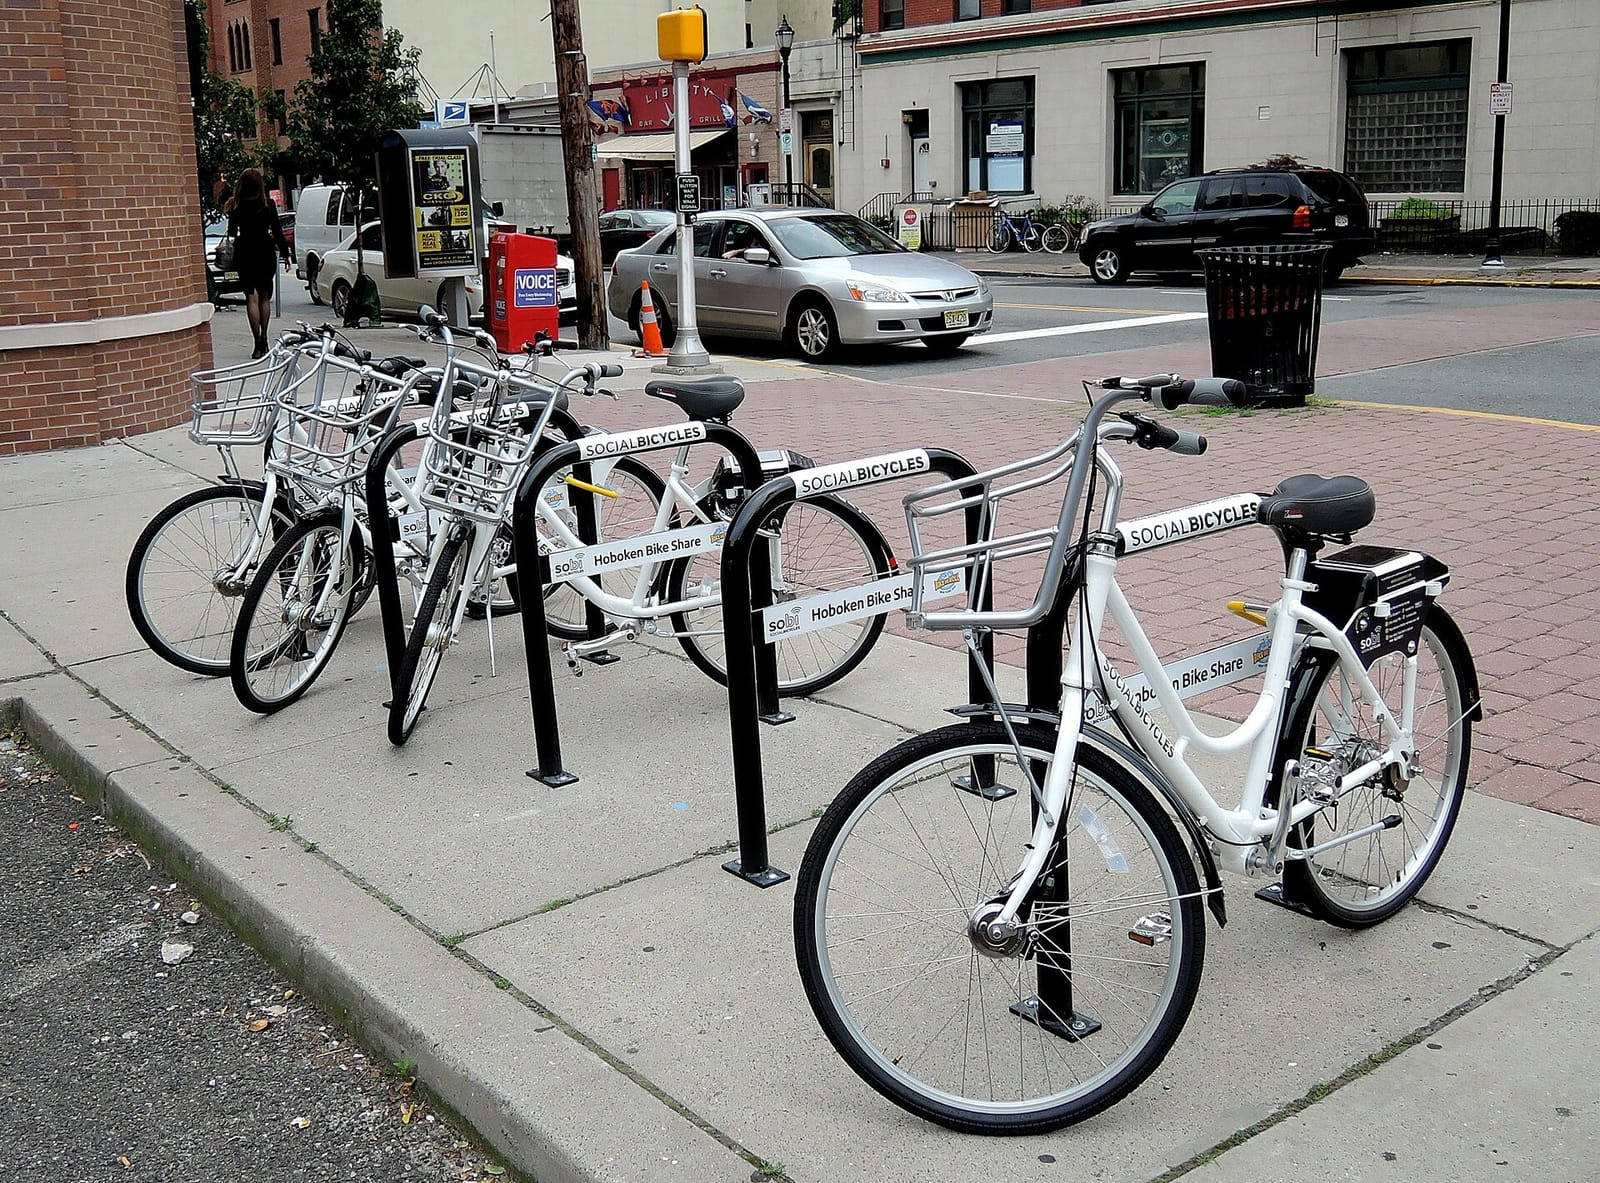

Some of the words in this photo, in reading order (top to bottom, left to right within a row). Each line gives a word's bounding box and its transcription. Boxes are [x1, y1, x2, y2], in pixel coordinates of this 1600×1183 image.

[645, 85, 711, 105] LIBTY
[519, 274, 554, 289] VOICE
[586, 427, 701, 457] SOCIALBICYCLES
[801, 456, 925, 493] SOCIALBICYCLES
[1130, 502, 1258, 547] SOCIALBICYCLES
[554, 558, 583, 574] sobi
[593, 548, 644, 567] Hoboken
[645, 542, 670, 559] Bike
[671, 536, 702, 551] Share
[769, 612, 800, 632] sobi
[811, 600, 865, 622] Hoboken
[866, 589, 892, 607] Bike
[1182, 666, 1209, 689] Bike
[1210, 658, 1244, 679] Share
[1103, 659, 1175, 758] SOCIALBICYCLES
